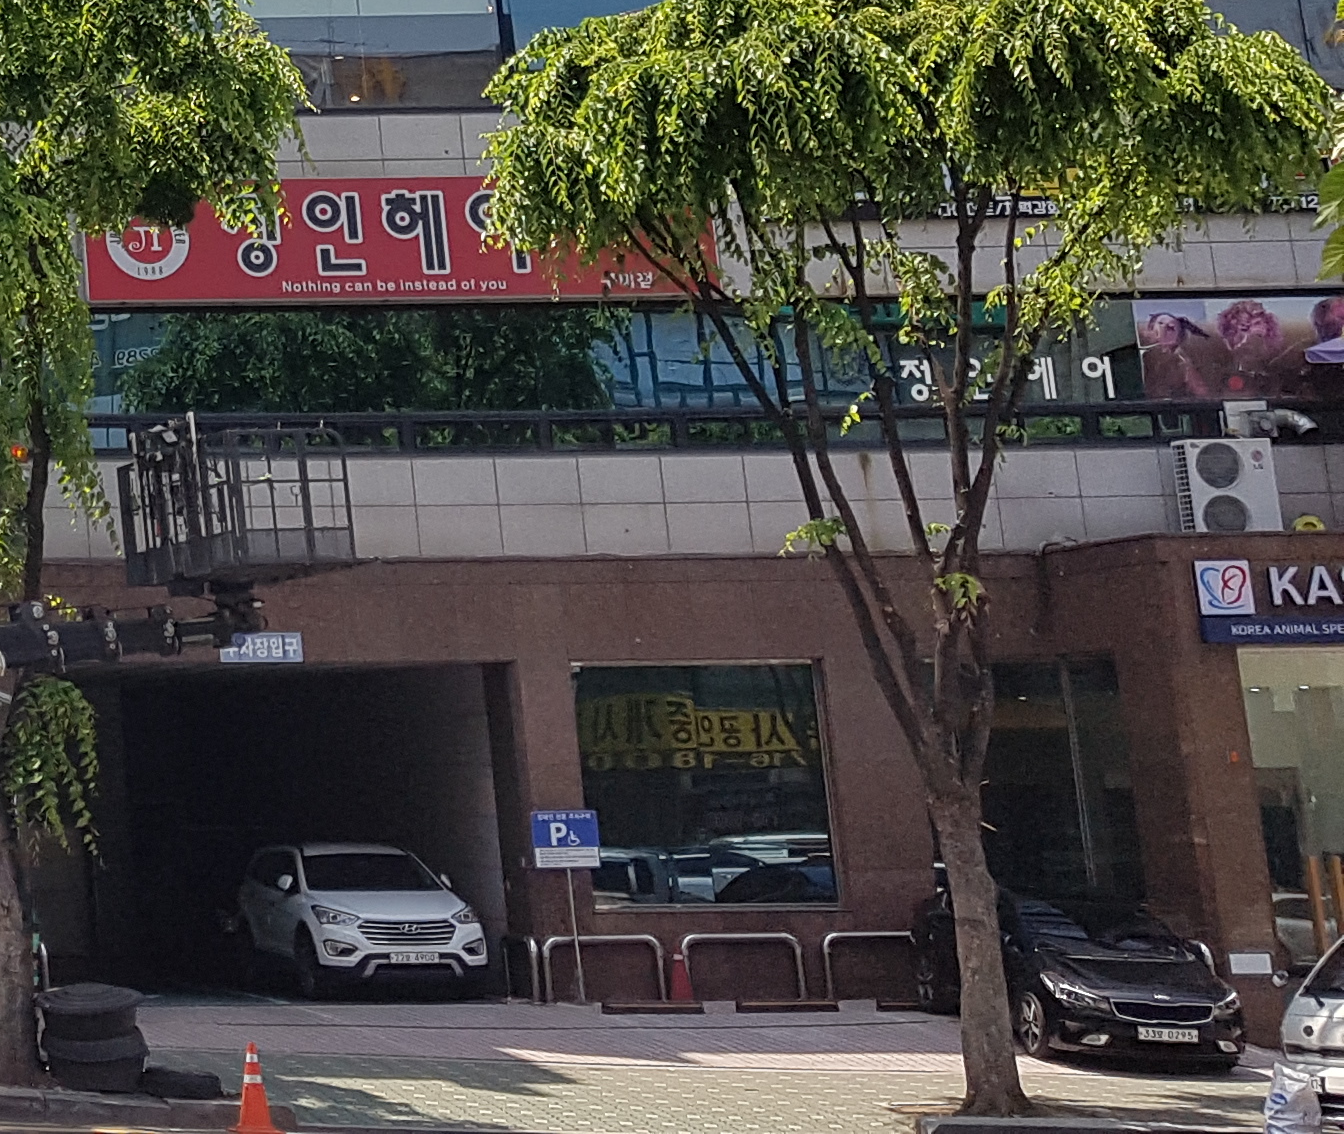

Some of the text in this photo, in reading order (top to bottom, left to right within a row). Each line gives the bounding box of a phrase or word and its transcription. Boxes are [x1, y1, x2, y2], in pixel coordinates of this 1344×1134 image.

[281, 278, 508, 296] Nothing can be instead of you
[1231, 624, 1320, 636] KOREA ANIMAL
[550, 822, 568, 847] P
